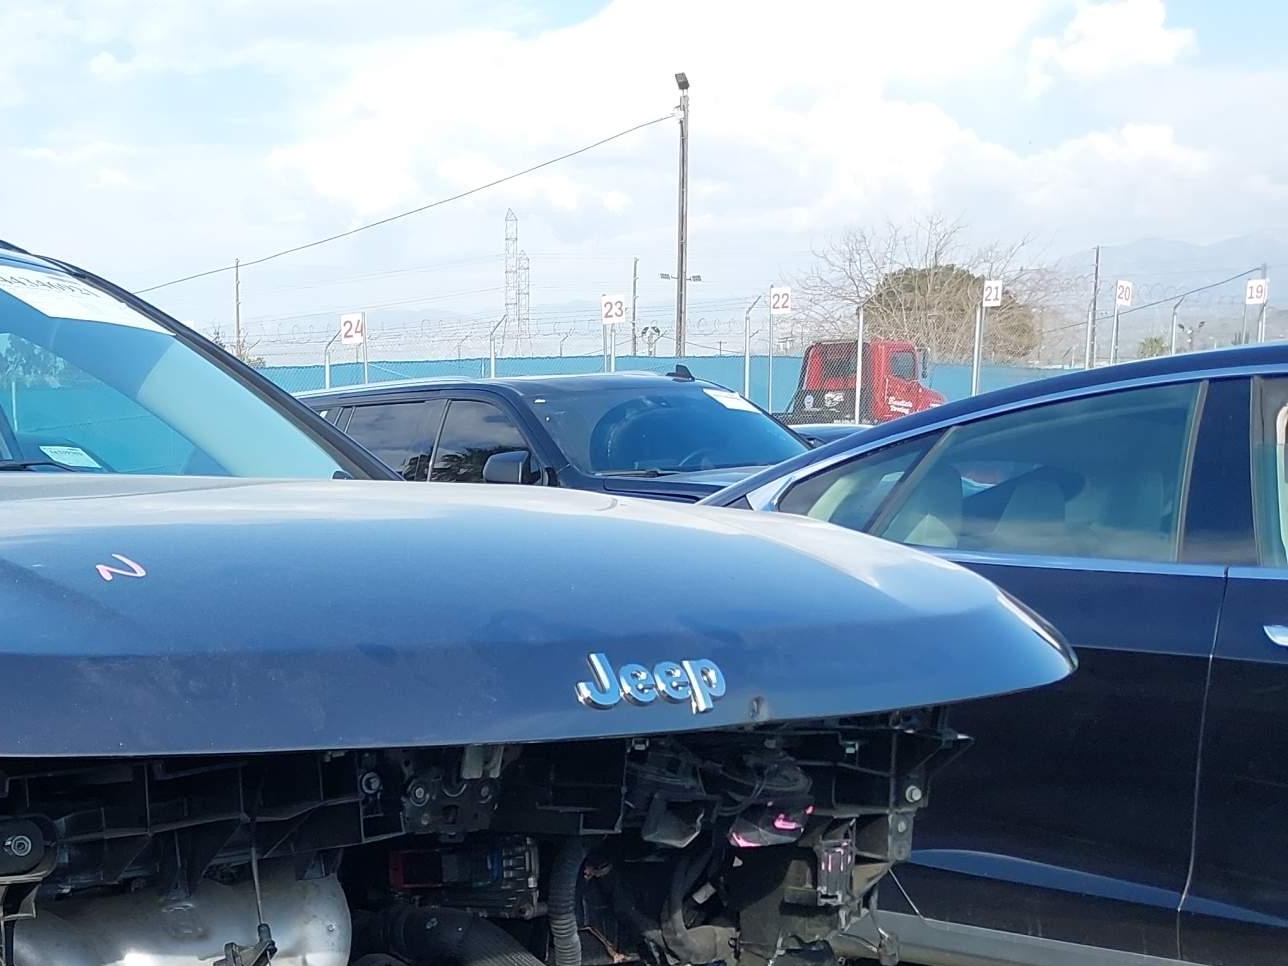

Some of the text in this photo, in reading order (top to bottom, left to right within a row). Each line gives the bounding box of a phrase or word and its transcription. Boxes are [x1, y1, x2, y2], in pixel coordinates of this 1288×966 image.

[985, 286, 999, 301] 21
[1118, 284, 1130, 301] 20
[1247, 284, 1263, 299] 19
[604, 300, 623, 318] 23
[772, 293, 789, 309] 22
[343, 319, 363, 338] 24
[575, 653, 726, 713] Jeep
